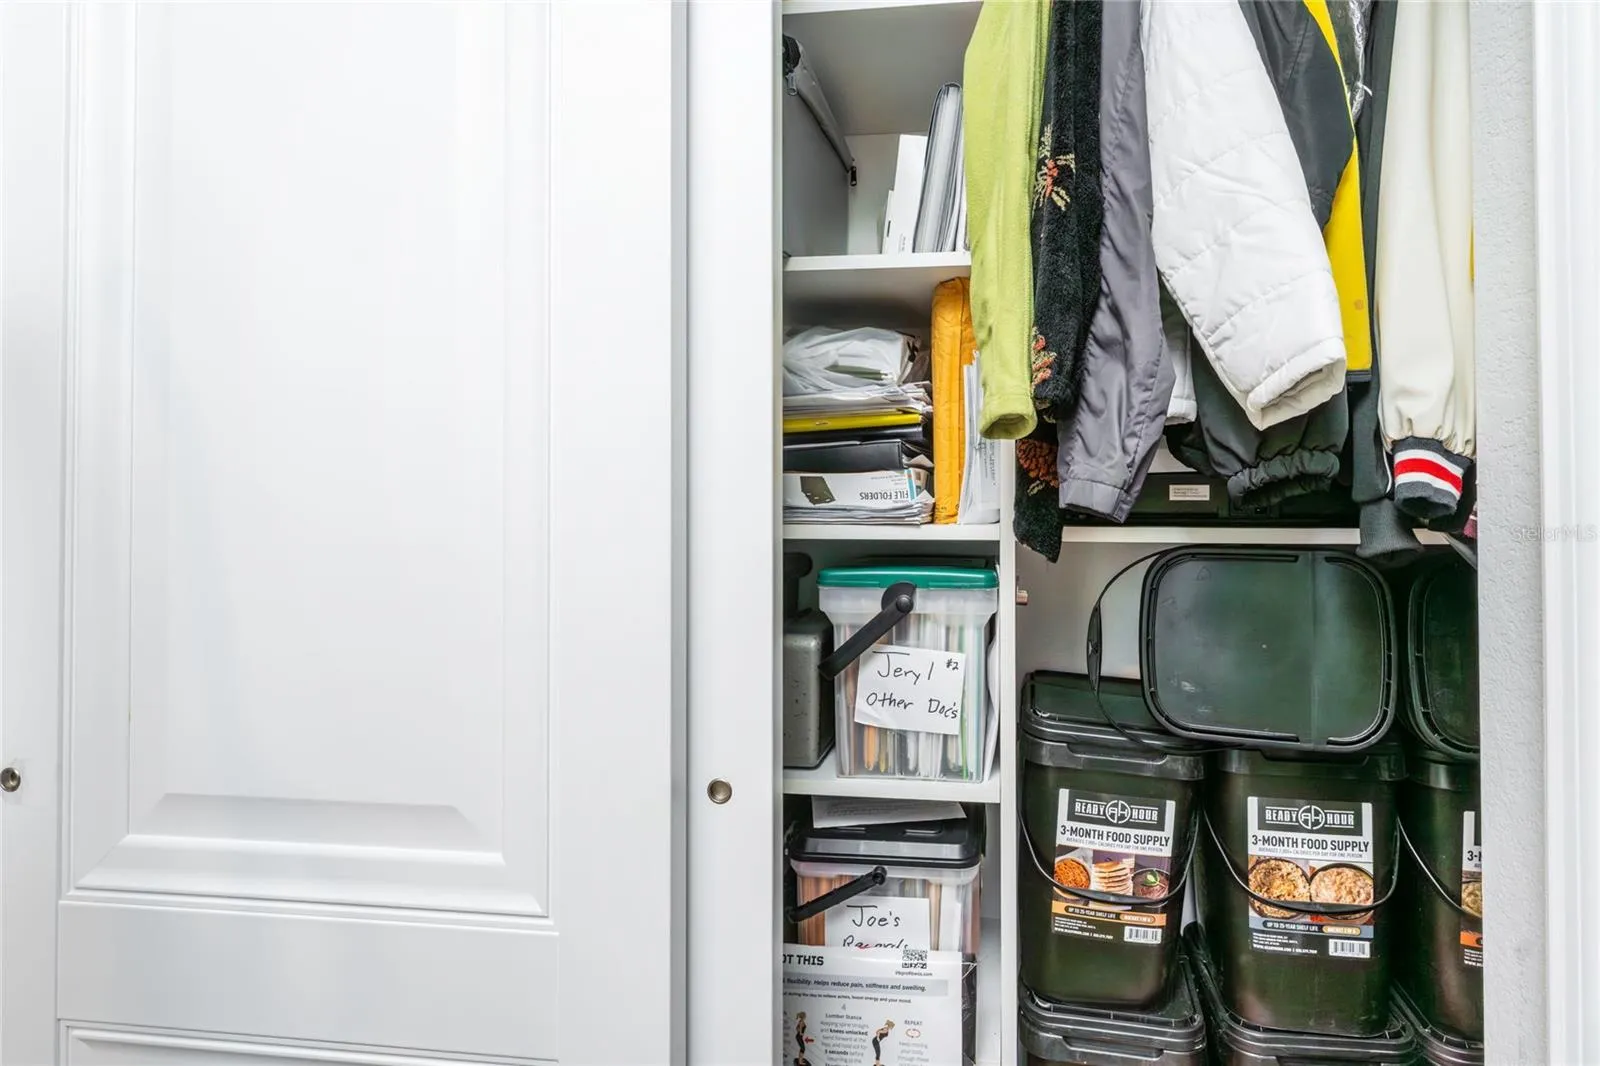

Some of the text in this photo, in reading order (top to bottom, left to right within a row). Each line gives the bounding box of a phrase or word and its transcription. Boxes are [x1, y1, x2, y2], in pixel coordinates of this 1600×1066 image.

[860, 490, 909, 500] FILE FOLDERS
[872, 650, 959, 685] Jeryl #2
[866, 692, 914, 710] Other
[1074, 802, 1105, 816] READY
[1132, 808, 1158, 821] HOUR
[1265, 809, 1298, 822] READY
[1326, 813, 1354, 826] HOUR
[1060, 824, 1170, 847] 3-MONTH FOOD SUPPLY
[1252, 834, 1370, 852] 3-MONTH FOOD SUPPLY
[846, 905, 901, 927] Joe's
[796, 954, 824, 966] THIS
